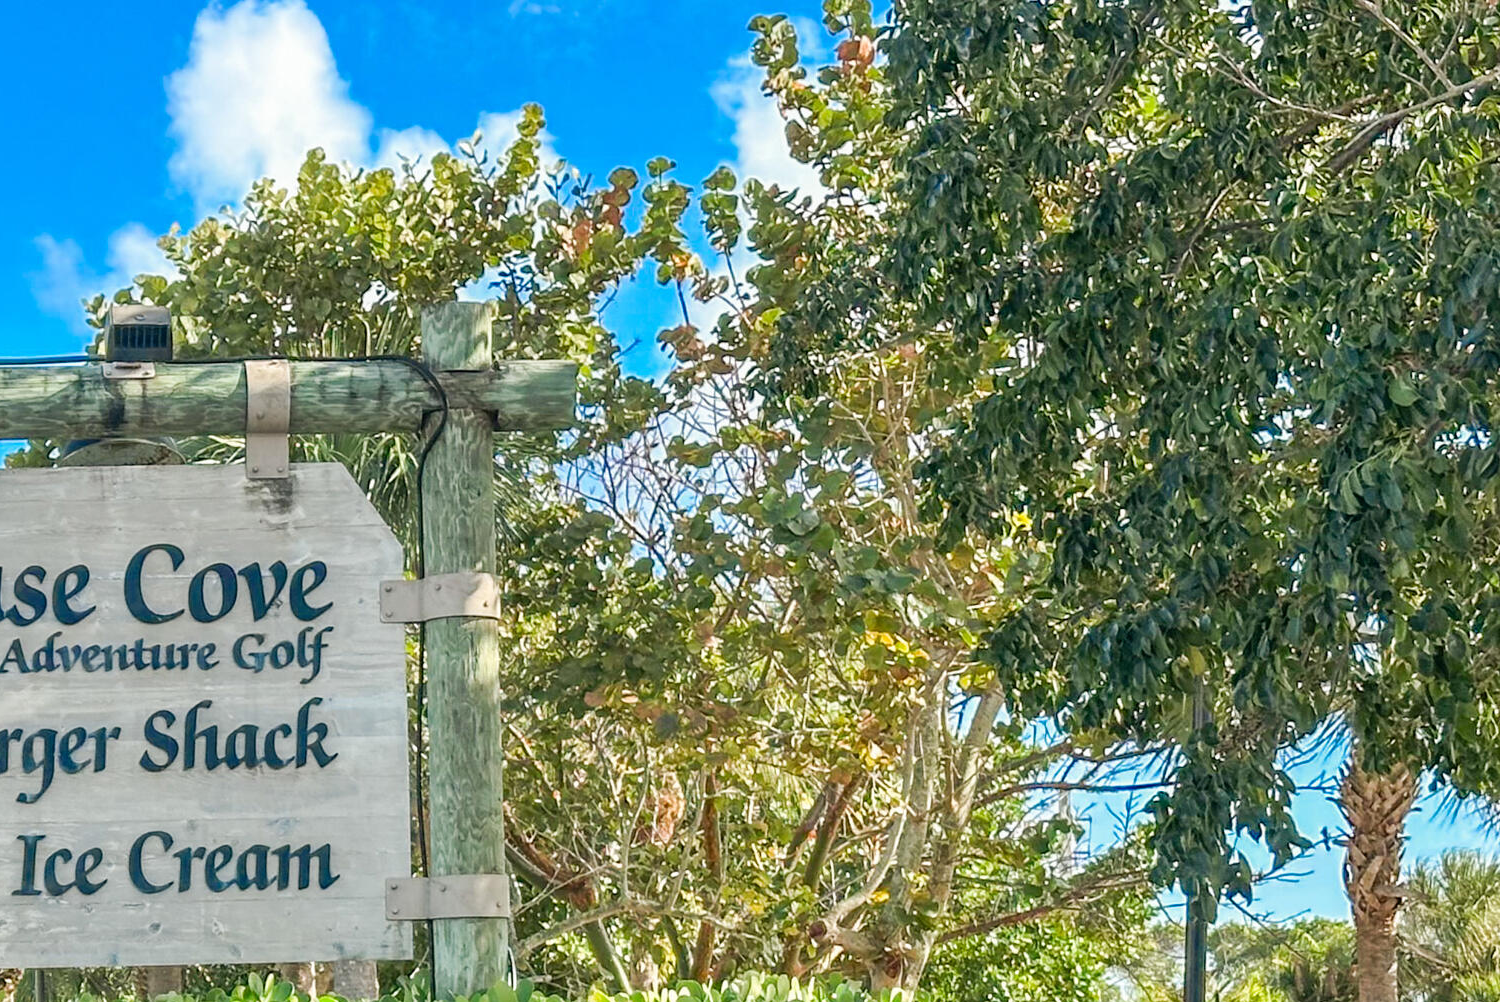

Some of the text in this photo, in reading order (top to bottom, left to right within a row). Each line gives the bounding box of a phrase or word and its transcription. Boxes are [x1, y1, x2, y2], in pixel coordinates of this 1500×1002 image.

[123, 543, 335, 625] Cove
[232, 626, 335, 685] Golf
[138, 696, 339, 773] Shack
[11, 834, 108, 897] Ice
[128, 830, 341, 895] Cream
